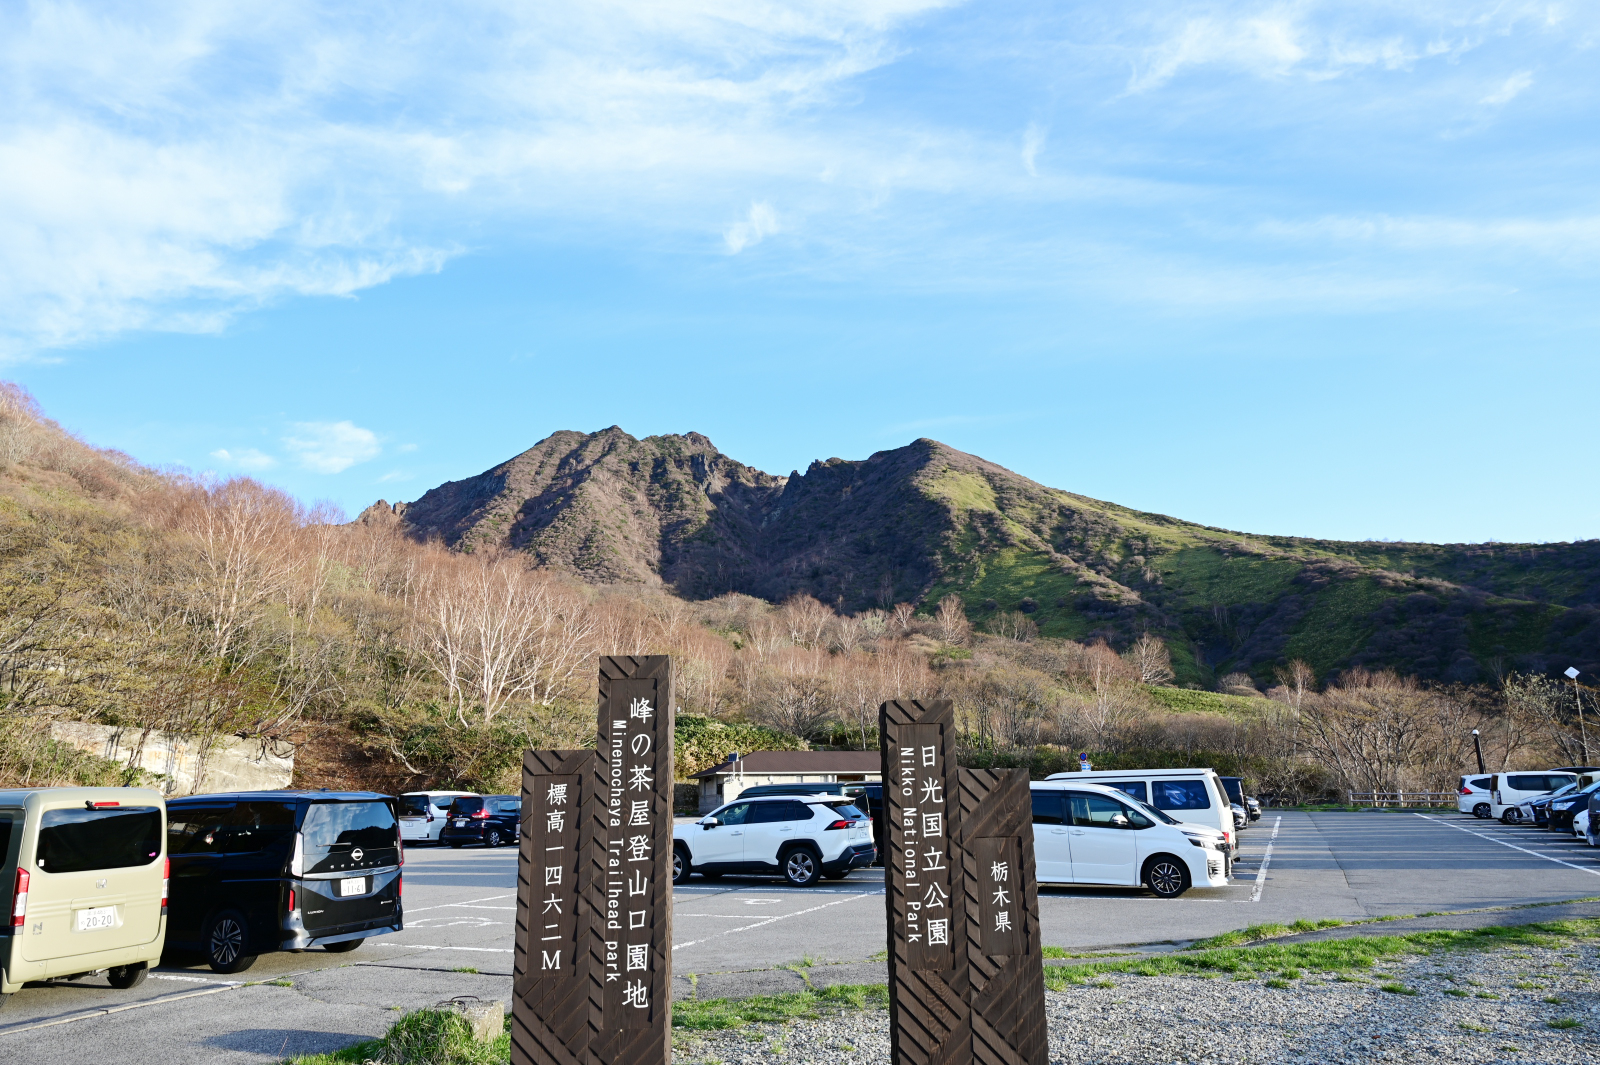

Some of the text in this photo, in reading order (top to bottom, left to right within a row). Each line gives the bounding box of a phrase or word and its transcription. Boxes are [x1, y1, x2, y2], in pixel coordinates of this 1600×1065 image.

[540, 782, 568, 970] 標高一四六二M
[604, 719, 625, 983] Minenochaya Trailhead park
[621, 696, 655, 1009] 峰の茶屋登山口園地
[900, 747, 923, 943] Nikko National Park
[919, 744, 949, 947] 日光国立公園
[990, 860, 1012, 933] 栃木県
